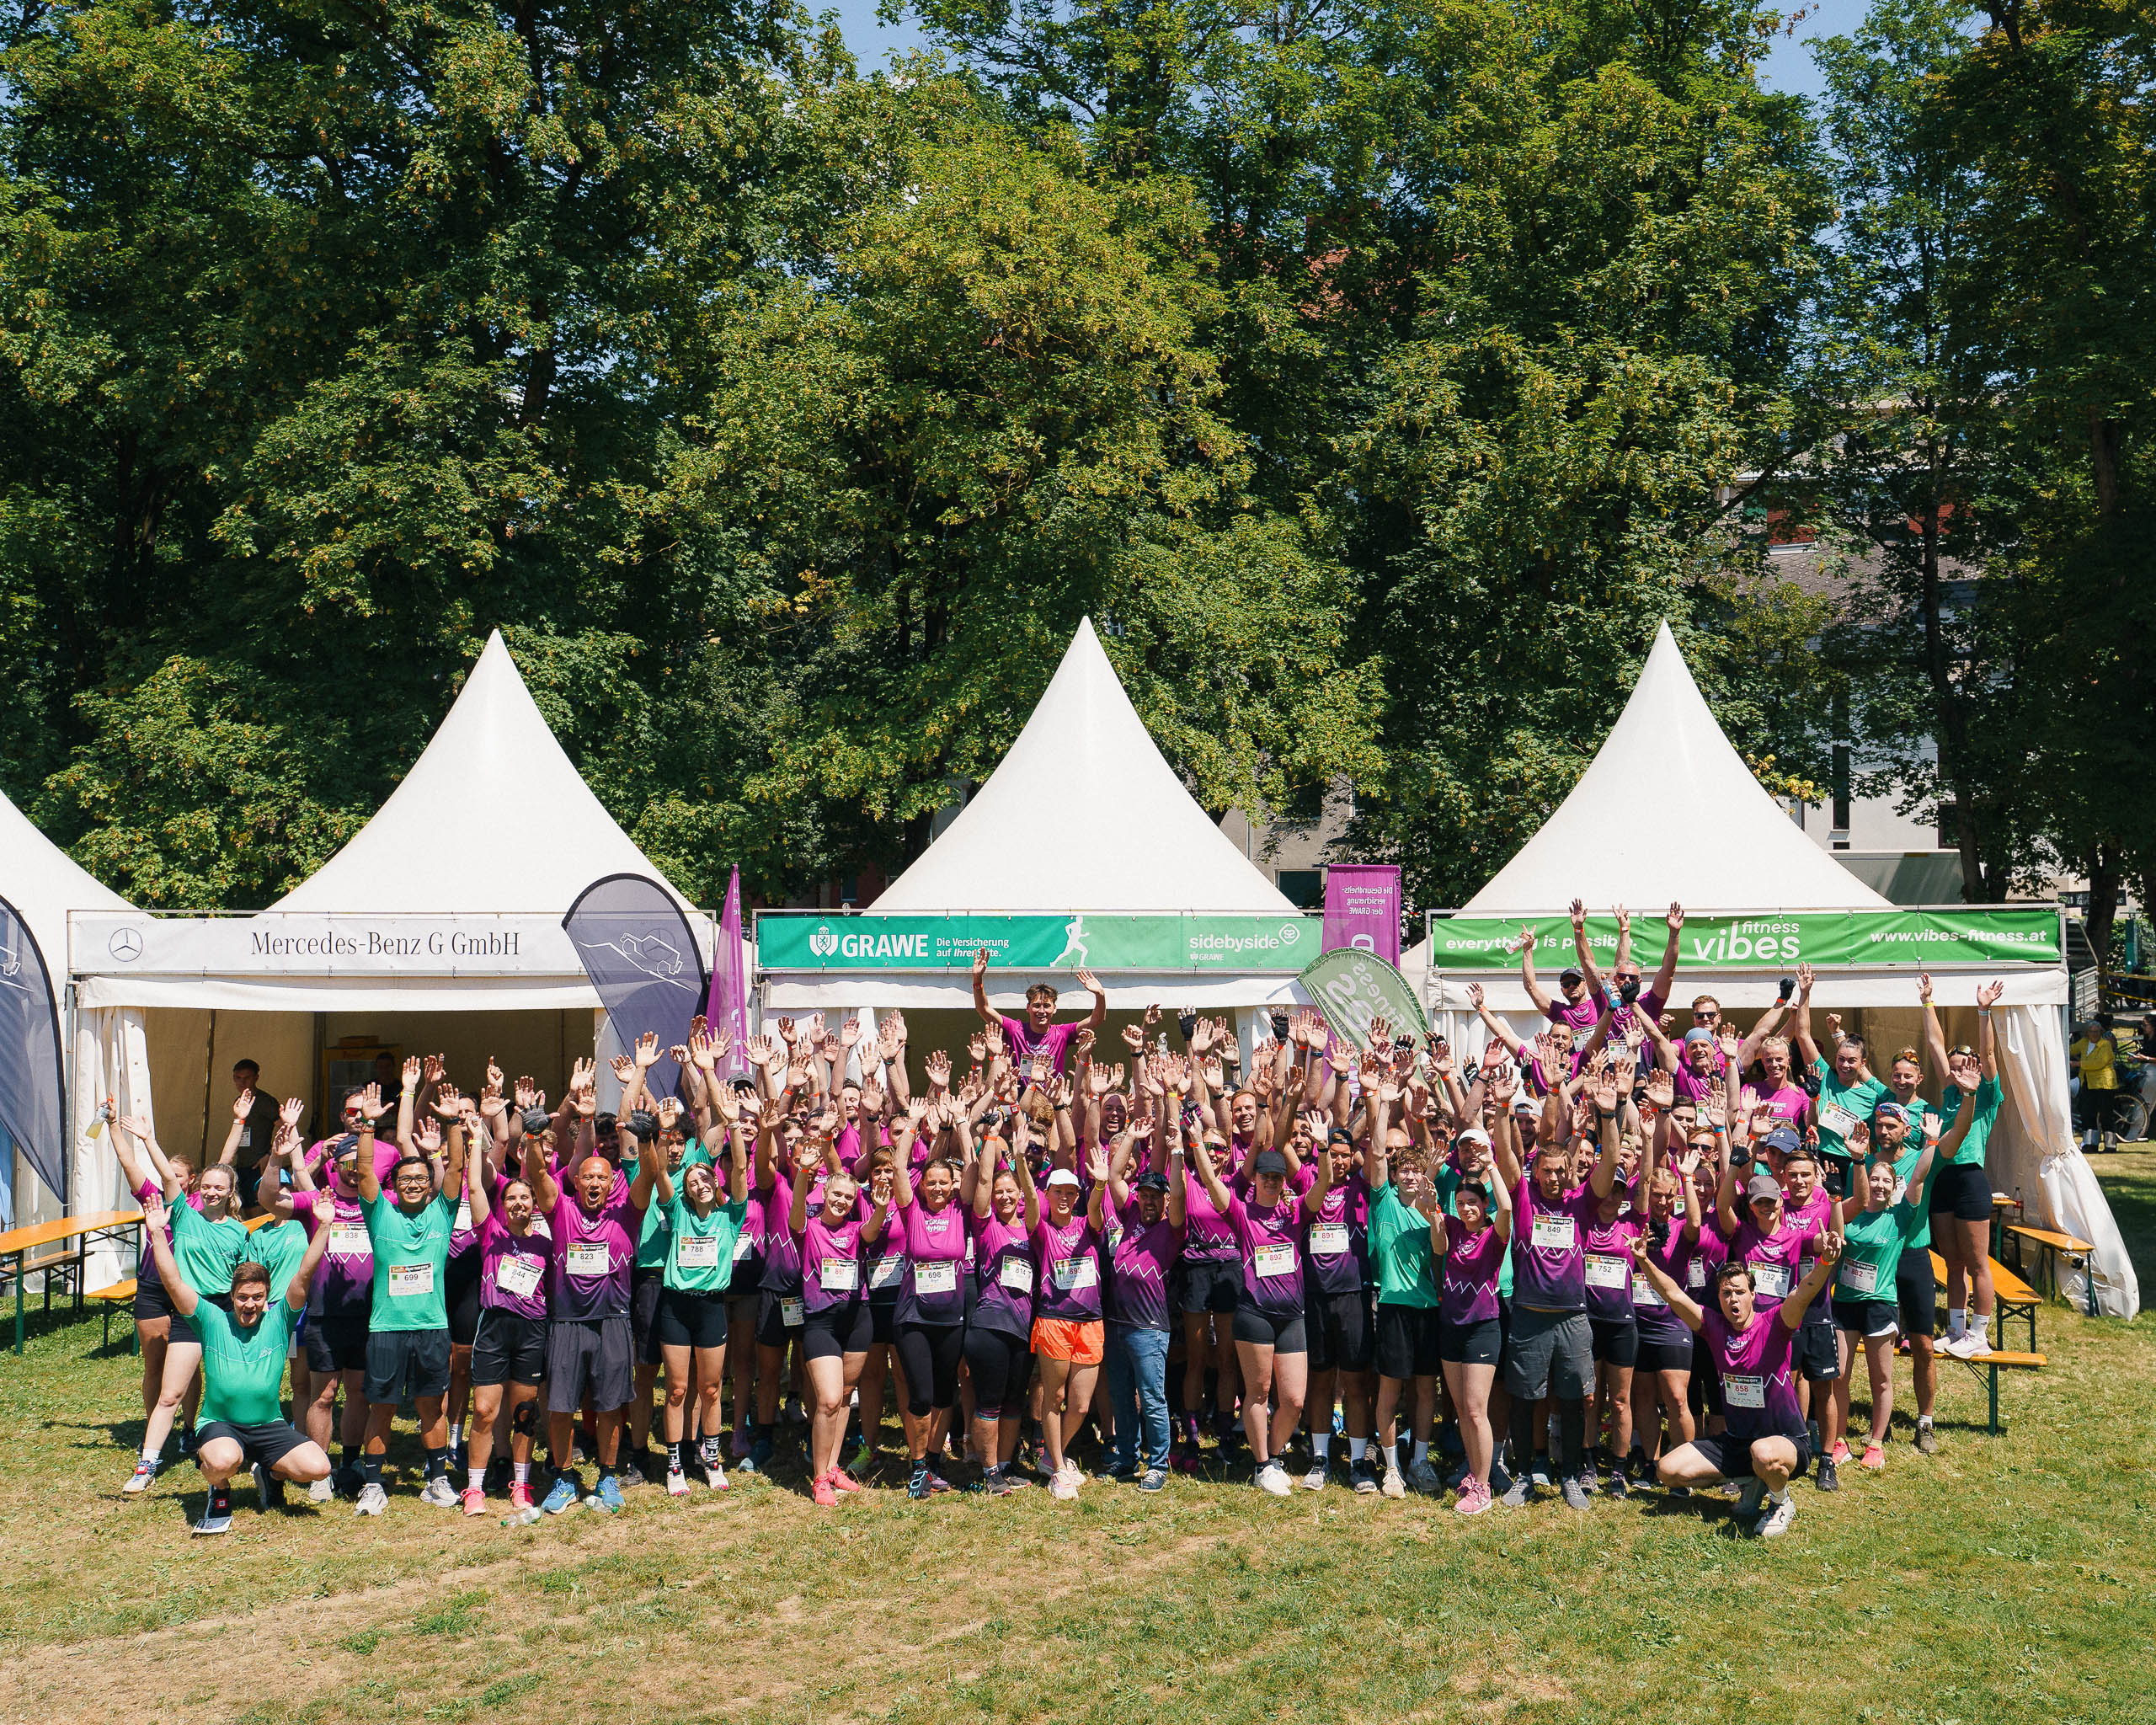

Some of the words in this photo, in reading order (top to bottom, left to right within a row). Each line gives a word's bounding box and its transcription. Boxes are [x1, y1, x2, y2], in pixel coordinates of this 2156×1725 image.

[1742, 921, 1800, 934] fitness
[1543, 934, 1557, 948] is
[1561, 934, 1637, 949] pssib.
[1693, 921, 1801, 960] vibes
[1870, 929, 2047, 943] www.vibes-fitness.at
[251, 932, 420, 955] Mercedes-Benz
[429, 932, 444, 955] G
[451, 932, 520, 955] GmbH
[841, 934, 929, 958] GRAWE
[937, 937, 950, 947] Die
[953, 937, 1010, 948] Versicherung
[1189, 933, 1279, 953] sidebyside
[937, 948, 952, 957] auf
[977, 948, 1002, 957] Ste.
[1833, 1113, 1846, 1123] 825
[1269, 1252, 1283, 1261] 892
[511, 1268, 526, 1279] 844
[1015, 1266, 1027, 1275] 814
[1598, 1265, 1612, 1274] 752
[1852, 1268, 1864, 1278] 882
[404, 1273, 419, 1281] 699
[1762, 1272, 1775, 1280] 732
[667, 1443, 681, 1468] HELL
[705, 1436, 720, 1463] YEAH
